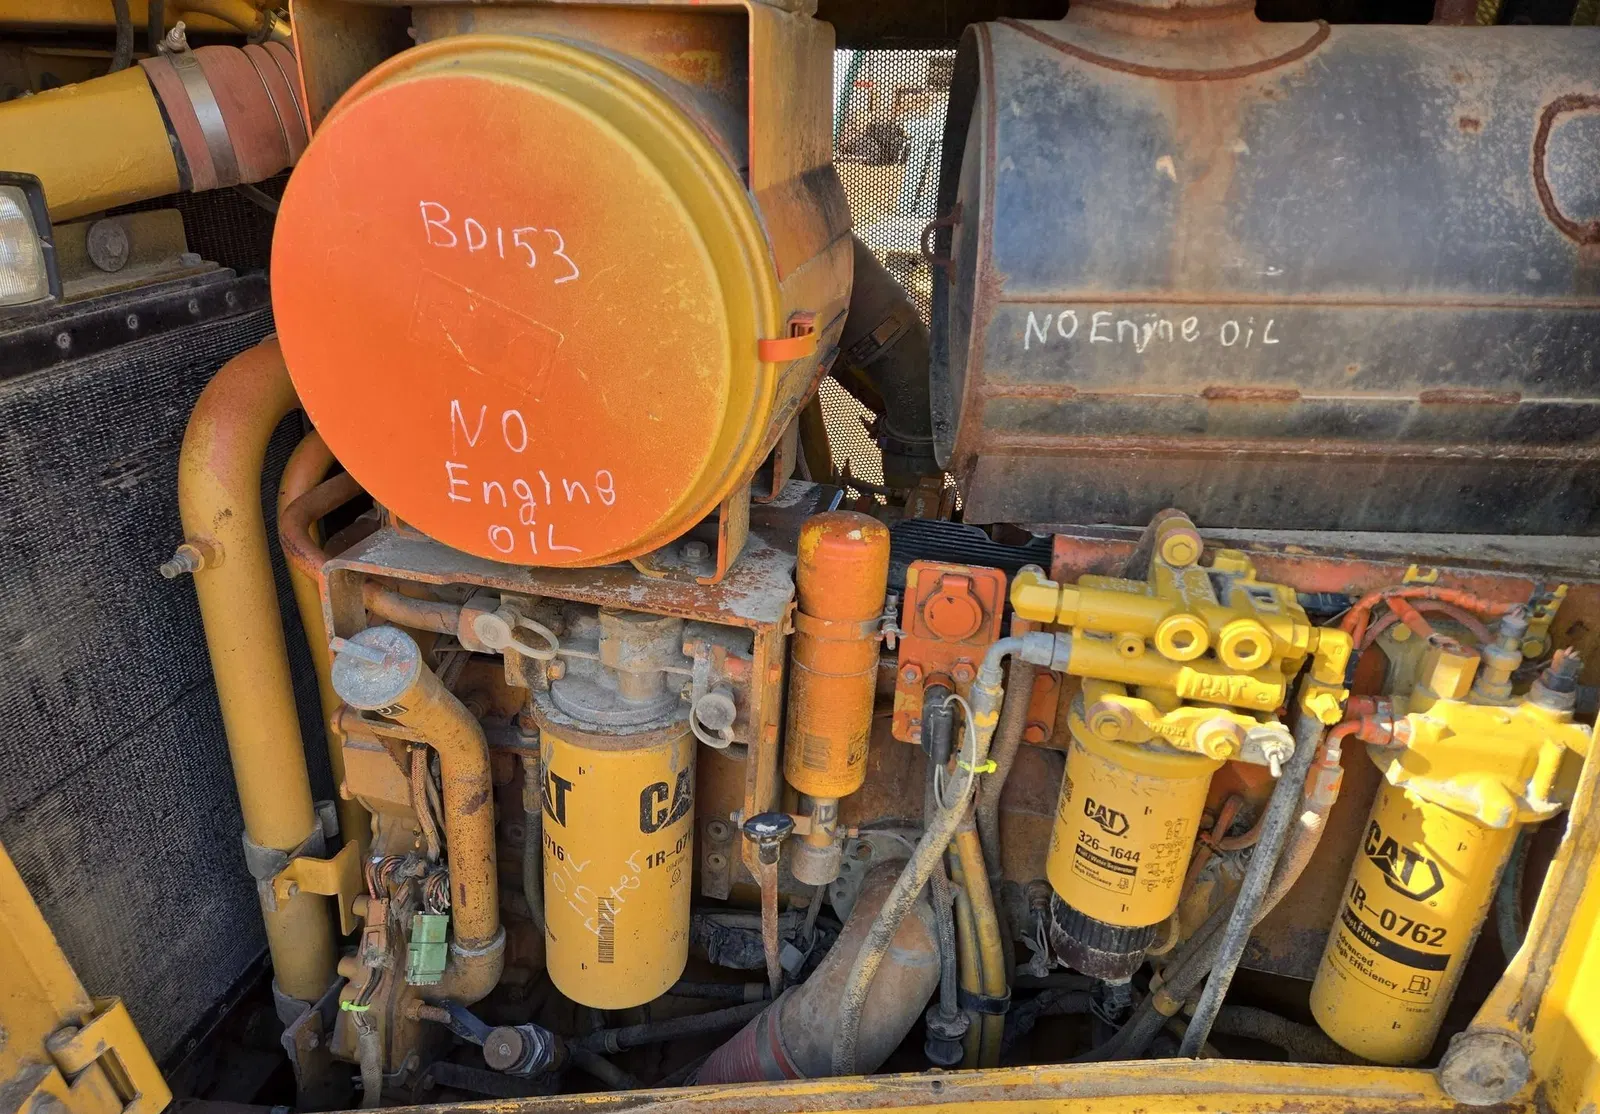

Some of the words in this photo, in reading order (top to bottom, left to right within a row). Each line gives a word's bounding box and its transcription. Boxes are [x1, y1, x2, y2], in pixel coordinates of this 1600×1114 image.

[420, 200, 580, 284] BD153
[1024, 309, 1079, 351] NO
[450, 399, 528, 456] NO
[1084, 797, 1121, 830] CAT
[1077, 829, 1141, 864] 326-1644
[1364, 819, 1426, 887] CAT
[1349, 955, 1399, 991] Efficiency
